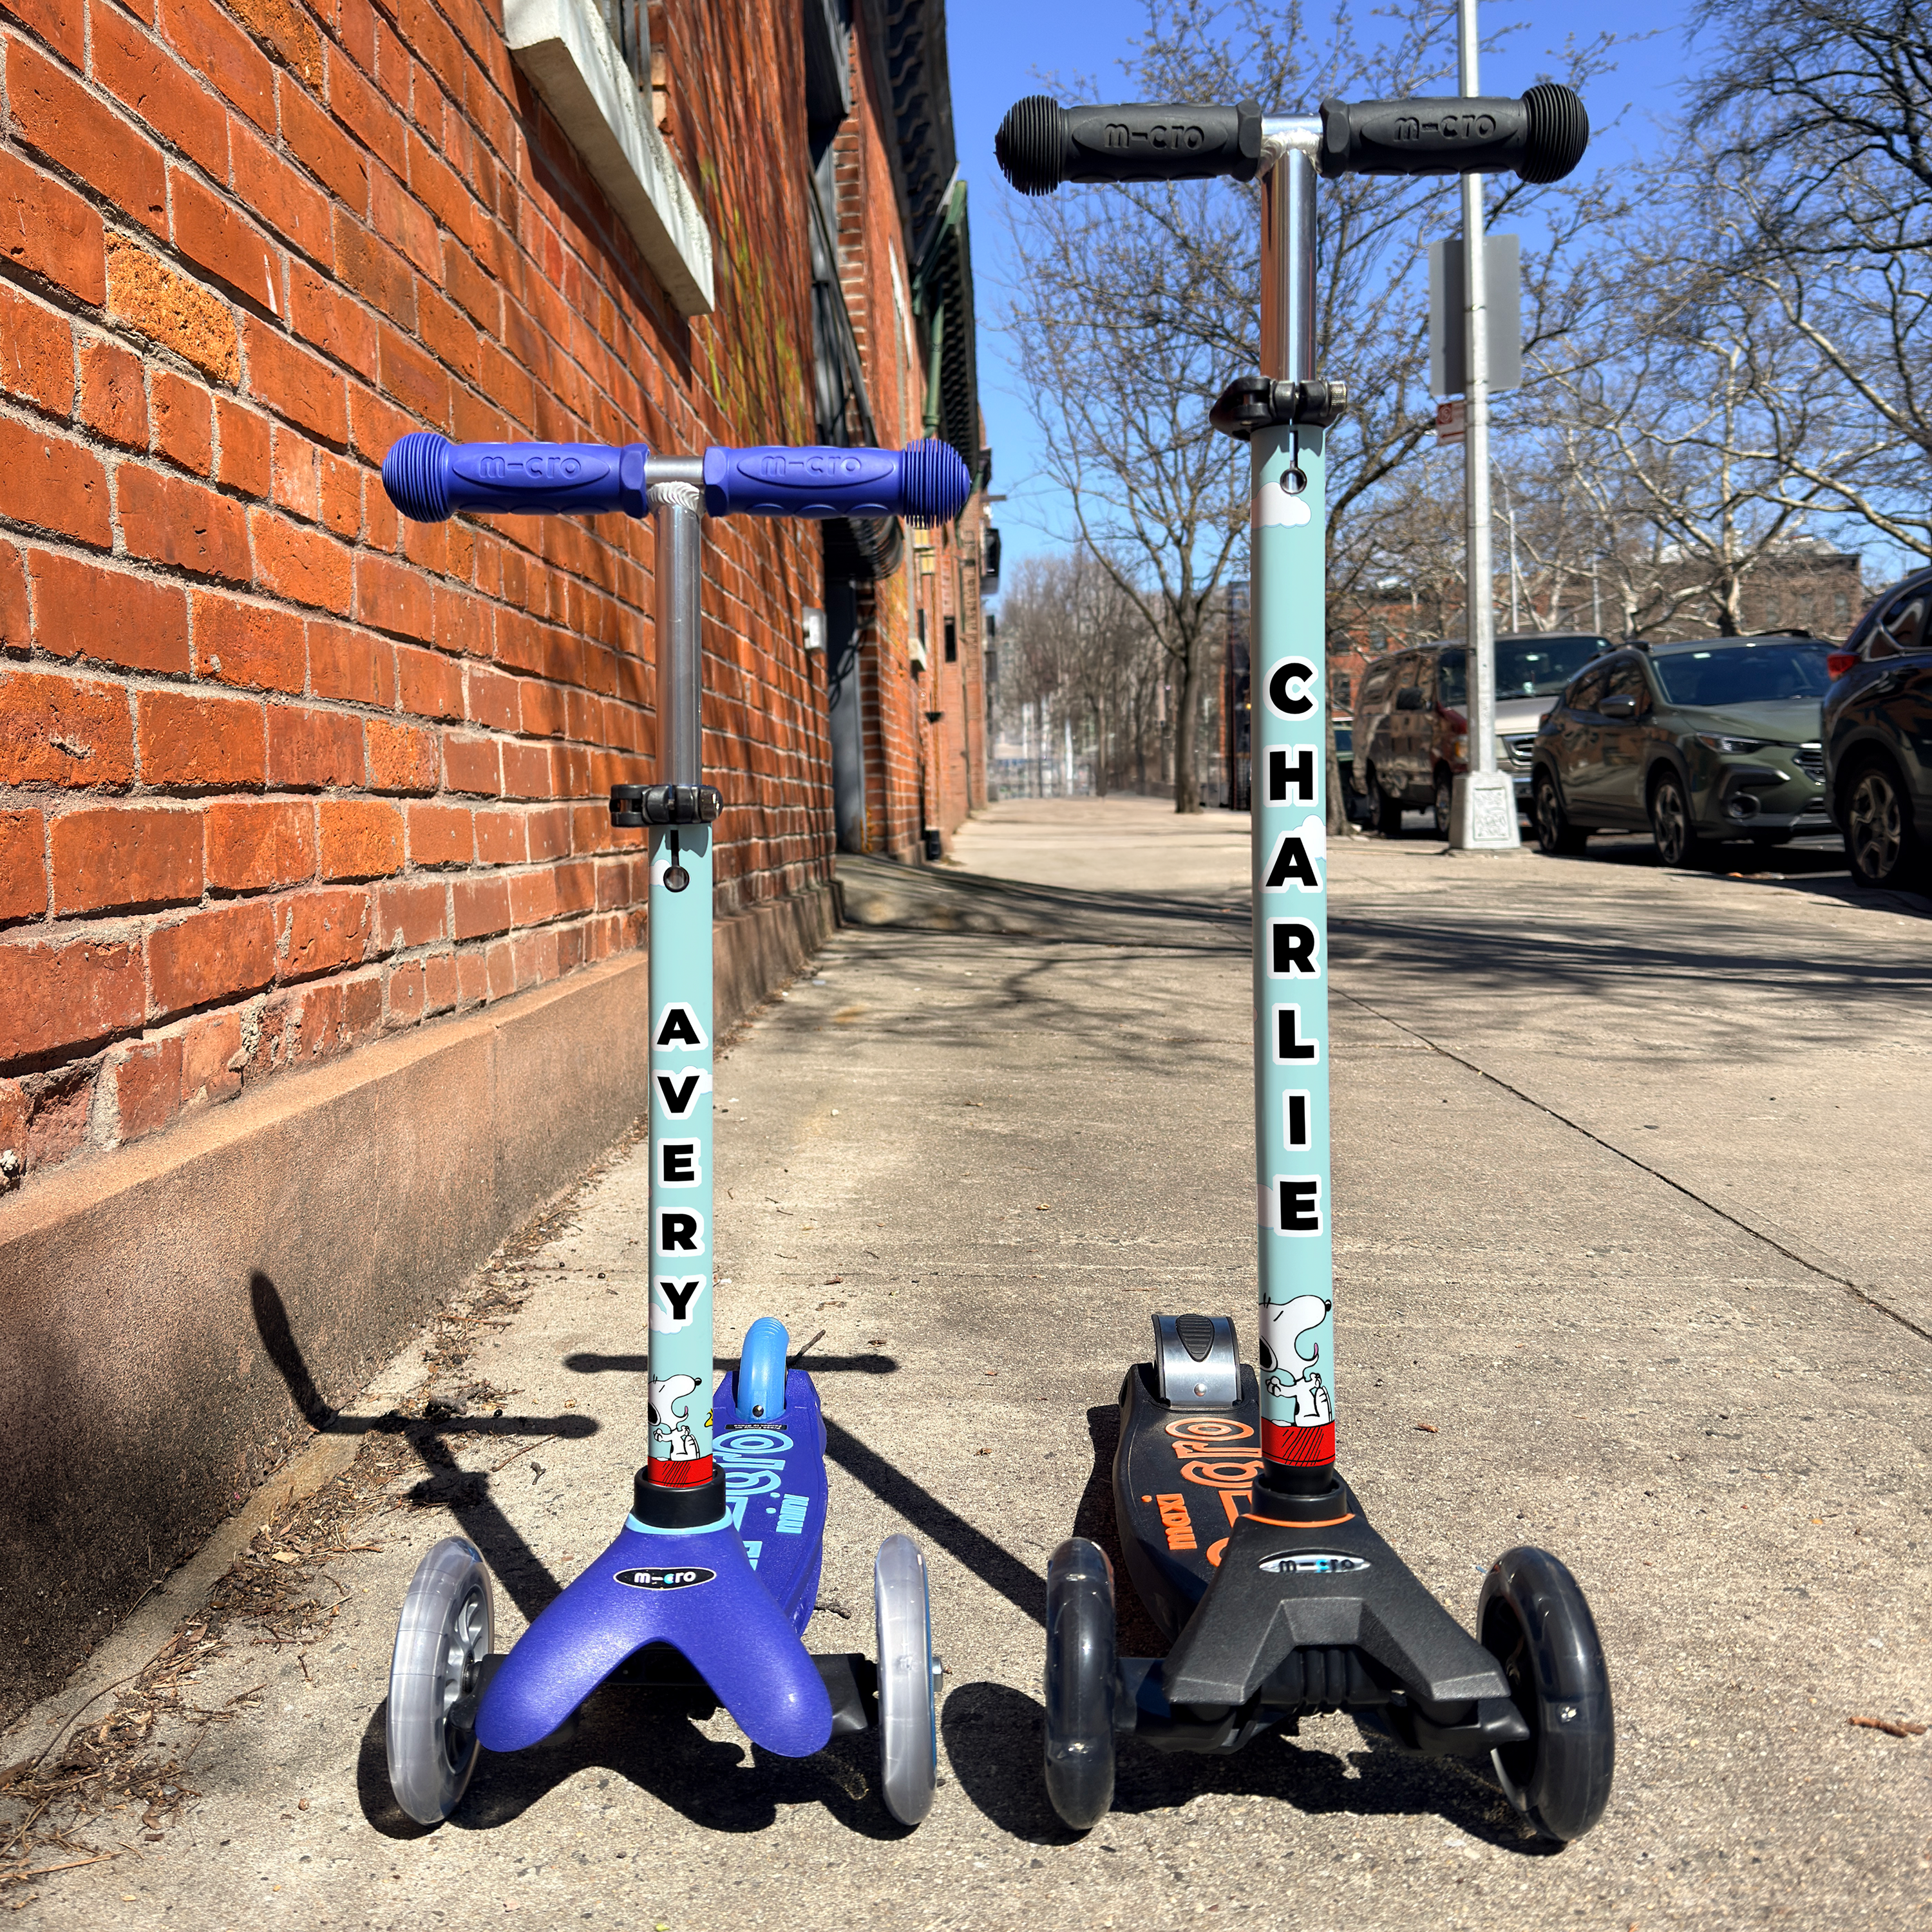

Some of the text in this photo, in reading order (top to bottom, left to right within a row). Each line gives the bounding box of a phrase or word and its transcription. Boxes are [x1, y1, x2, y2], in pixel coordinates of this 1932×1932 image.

[1265, 663, 1318, 1230] CHARLIE
[657, 1009, 700, 1320] AVERY
[1141, 1493, 1197, 1550] maxi
